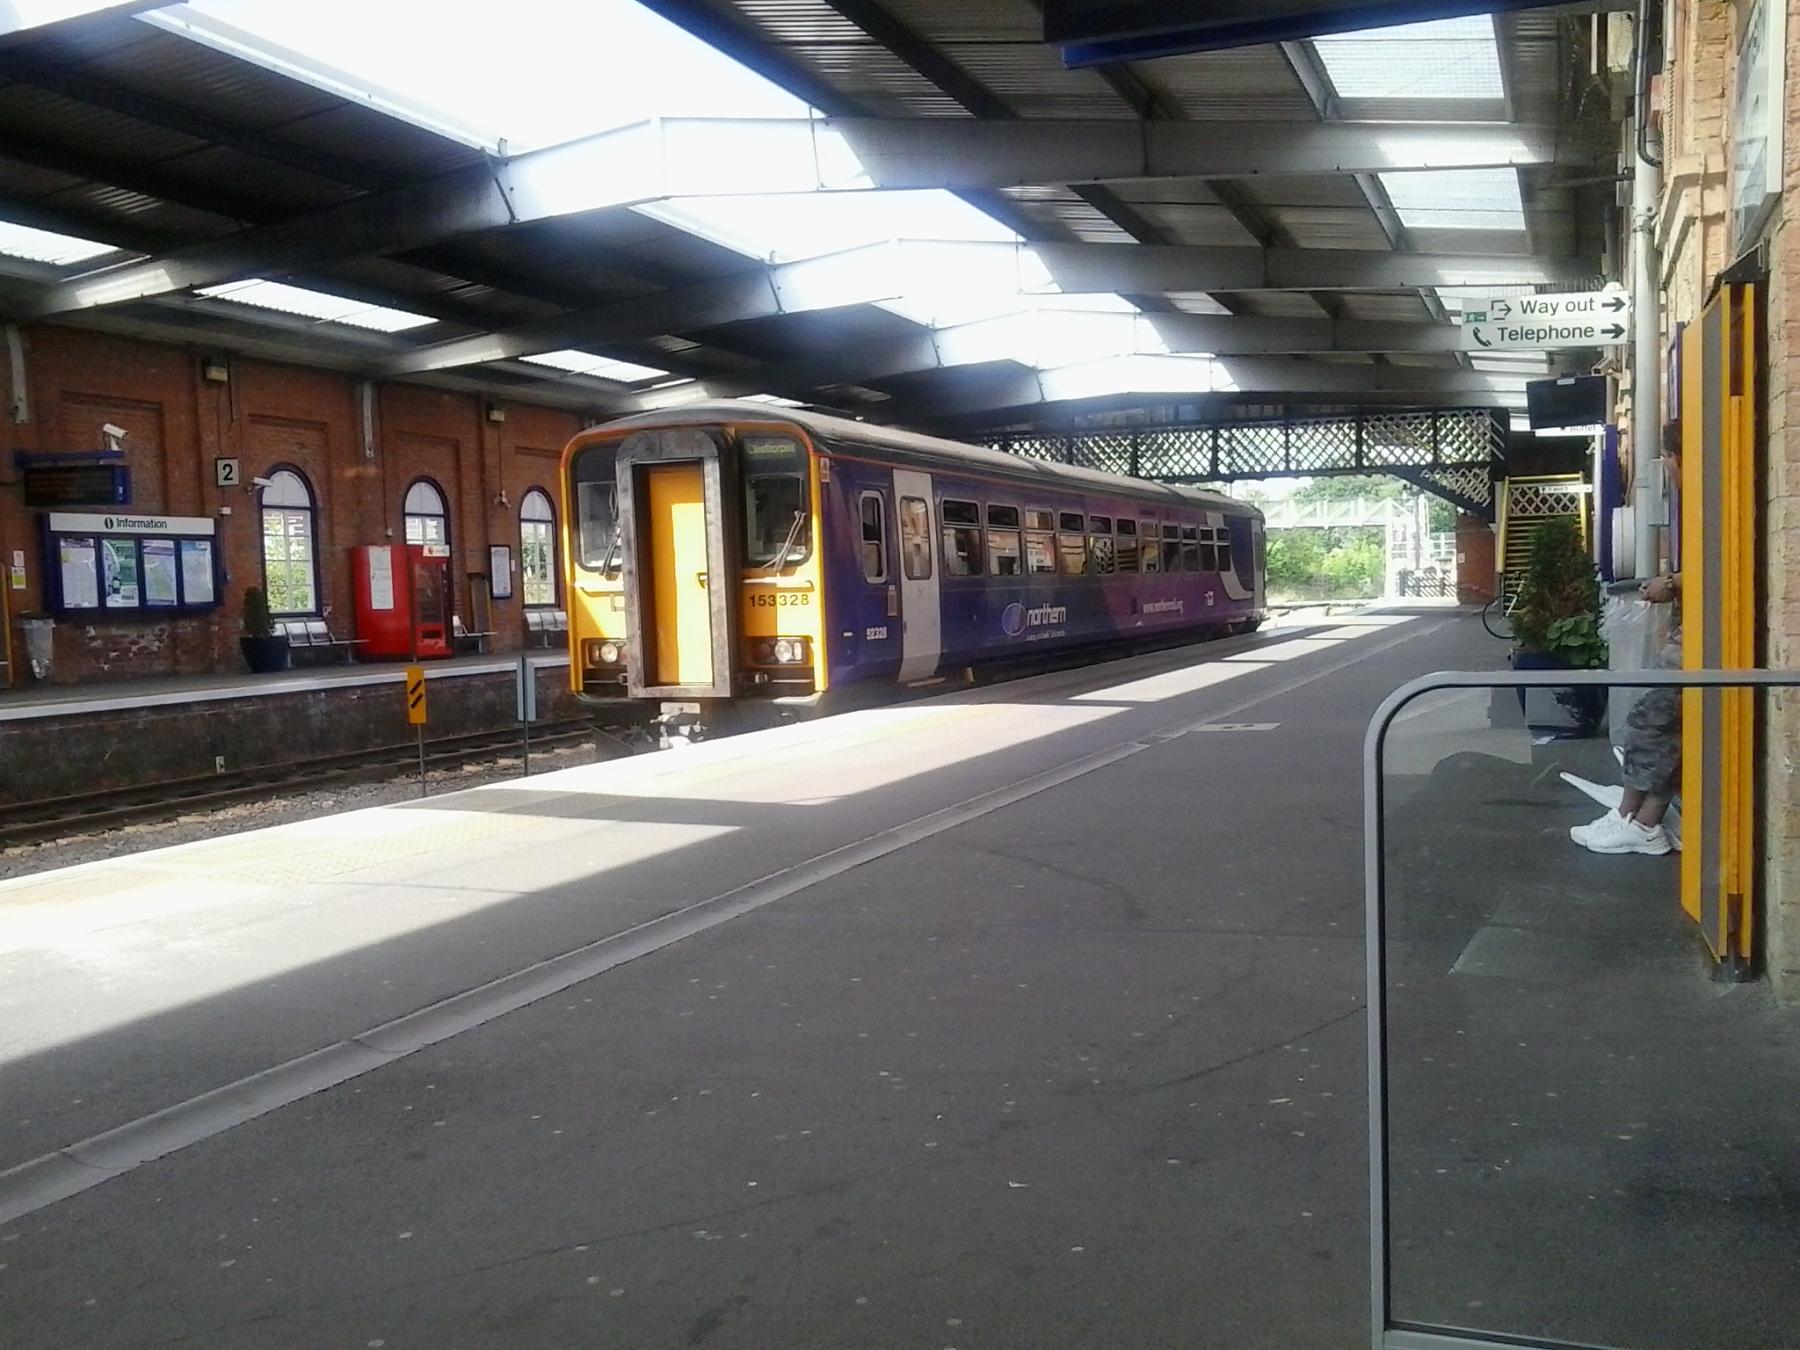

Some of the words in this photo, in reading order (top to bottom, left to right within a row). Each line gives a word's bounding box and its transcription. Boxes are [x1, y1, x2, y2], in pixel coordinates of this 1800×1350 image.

[1520, 299, 1559, 316] Way
[1565, 298, 1595, 312] out
[1497, 324, 1595, 343] Telephone
[222, 463, 234, 481] 2
[116, 518, 168, 529] Information
[750, 594, 810, 607] 153328
[1026, 602, 1067, 627] northern
